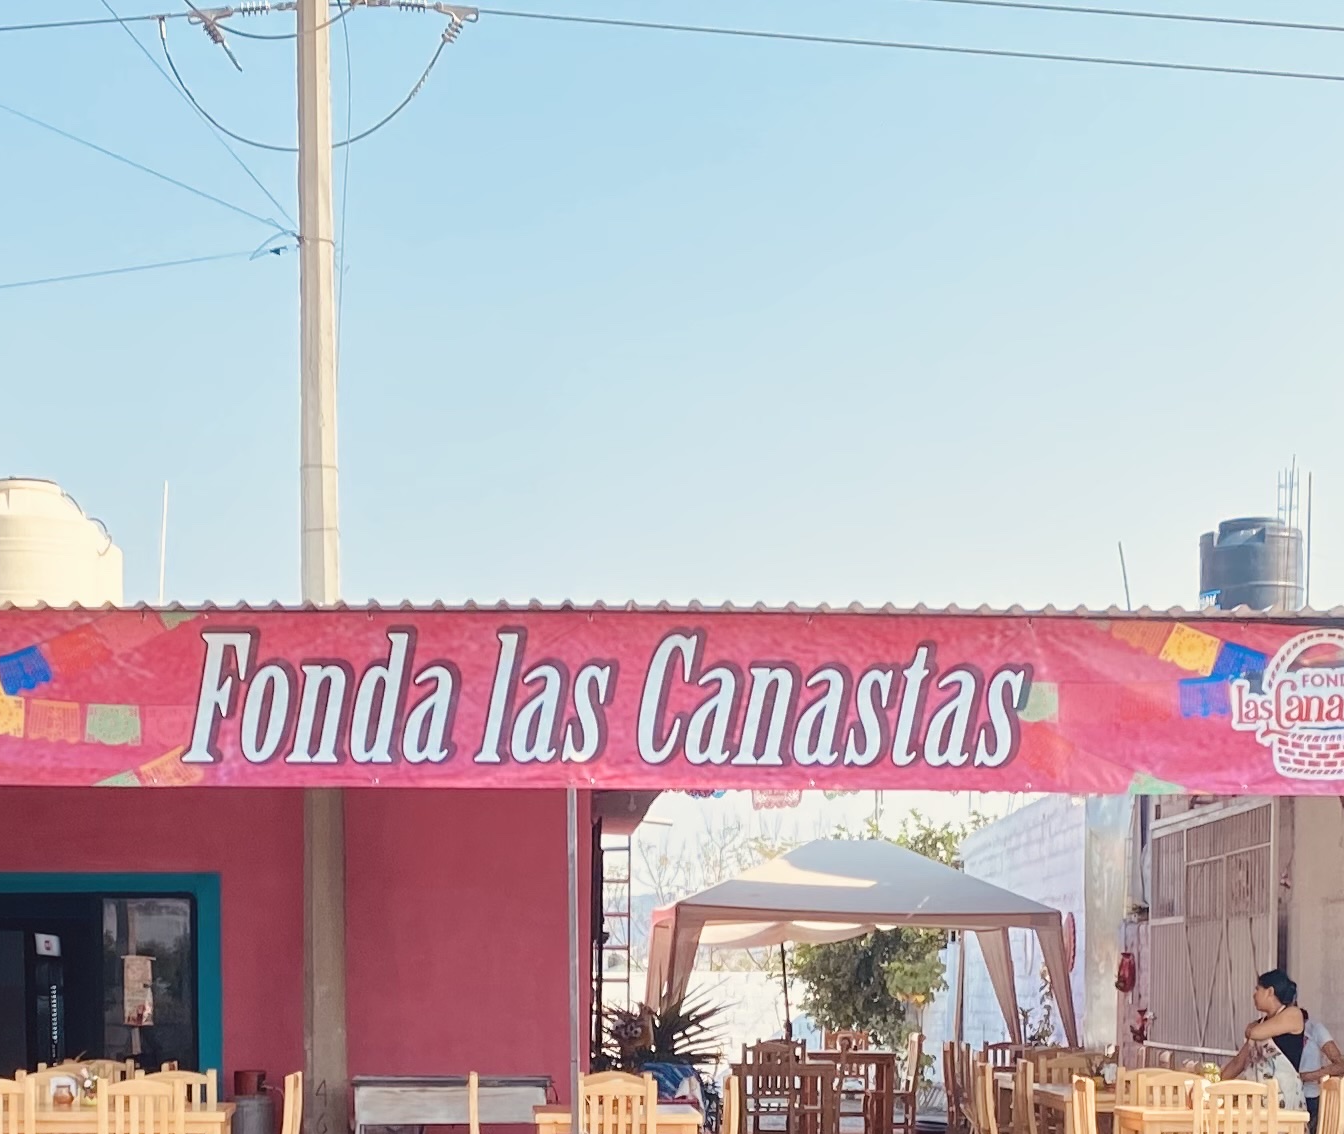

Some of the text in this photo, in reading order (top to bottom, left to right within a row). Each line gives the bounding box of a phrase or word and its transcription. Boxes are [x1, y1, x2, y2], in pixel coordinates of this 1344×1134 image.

[181, 632, 1030, 768] Fonda las Canastas
